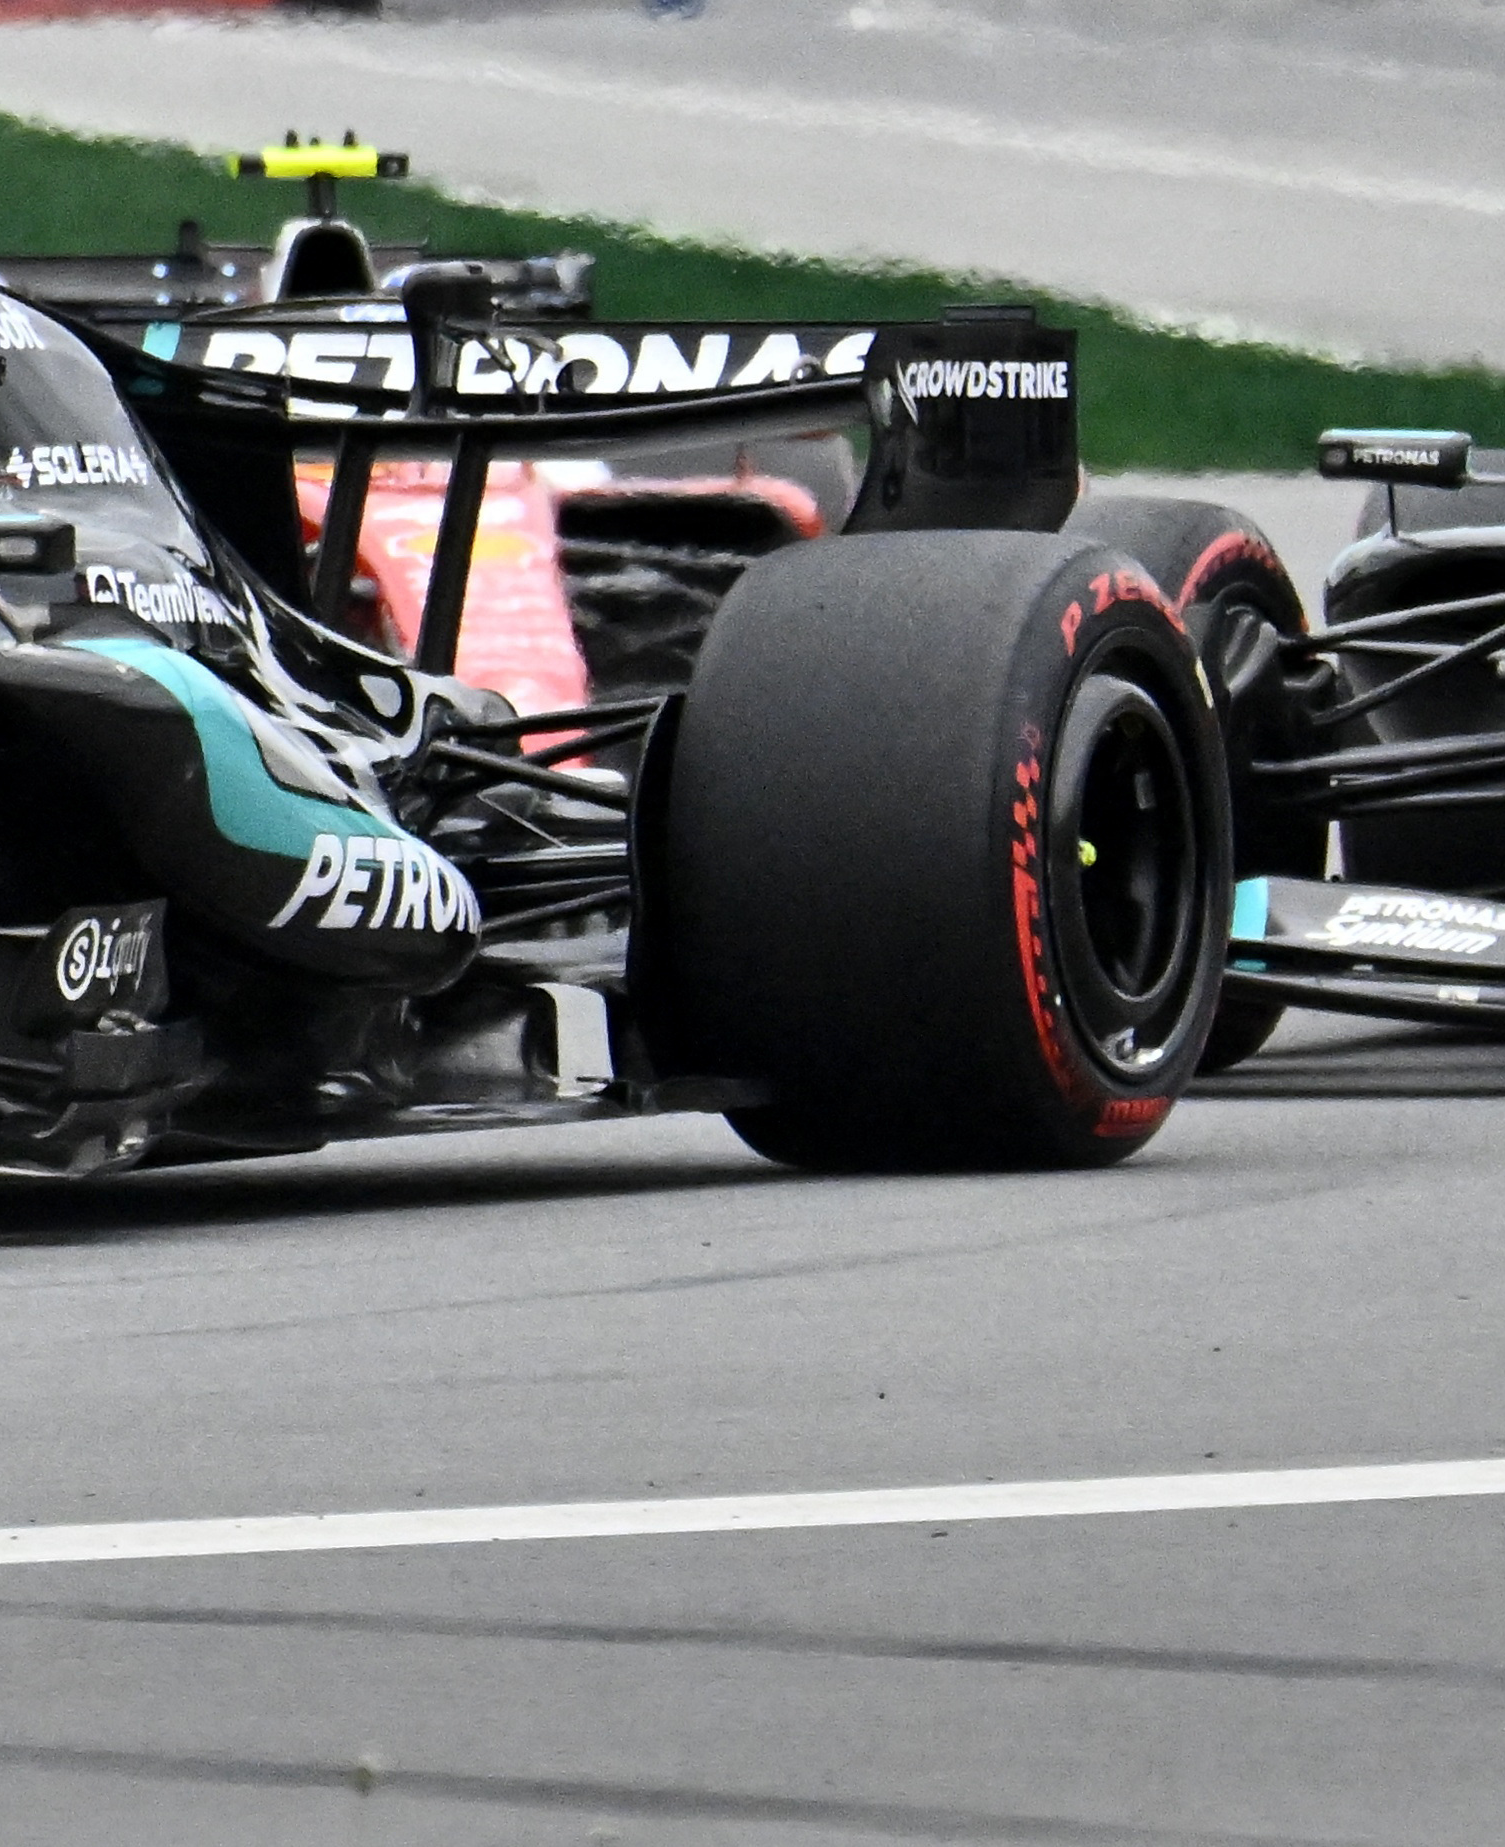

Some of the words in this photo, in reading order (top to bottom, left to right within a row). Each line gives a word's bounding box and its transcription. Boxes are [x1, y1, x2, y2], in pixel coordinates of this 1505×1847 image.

[902, 358, 1069, 400] CROWDSTRIKE
[30, 444, 134, 487] SOLERA
[1352, 448, 1441, 467] PETRONAS
[1304, 913, 1498, 955] Syntium
